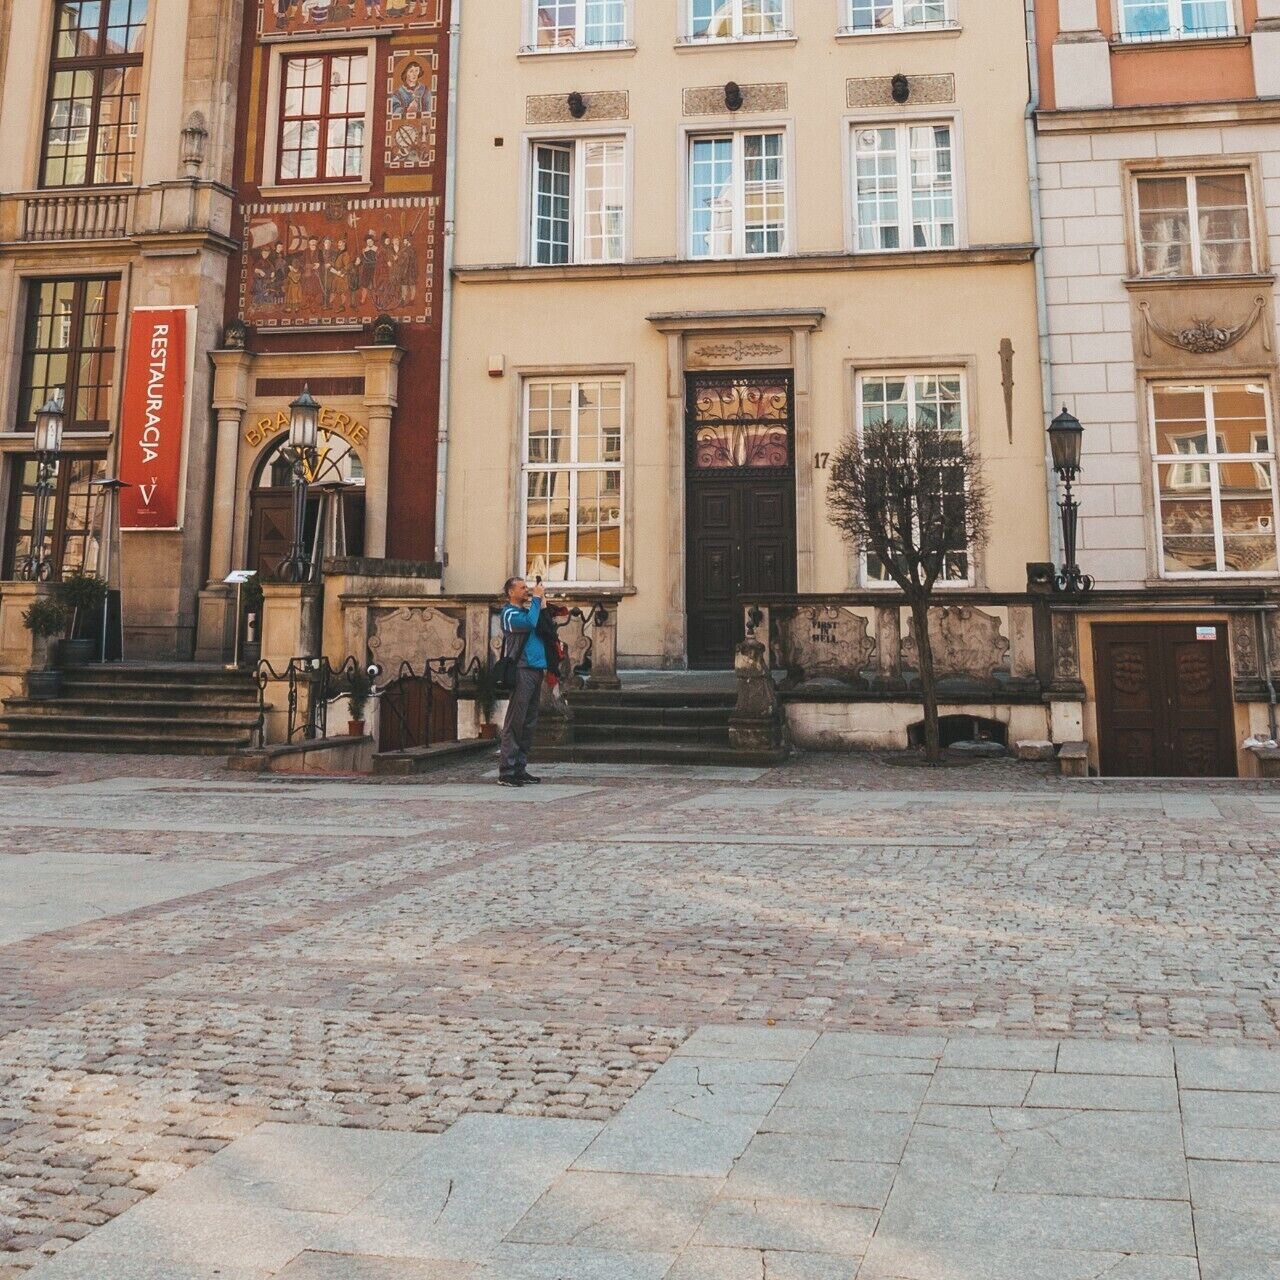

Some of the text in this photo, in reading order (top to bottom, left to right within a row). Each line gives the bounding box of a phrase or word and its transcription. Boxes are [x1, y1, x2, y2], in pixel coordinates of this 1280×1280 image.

[139, 324, 169, 464] RESTAURACJA
[245, 407, 369, 448] BRAERIE
[814, 452, 830, 469] 17
